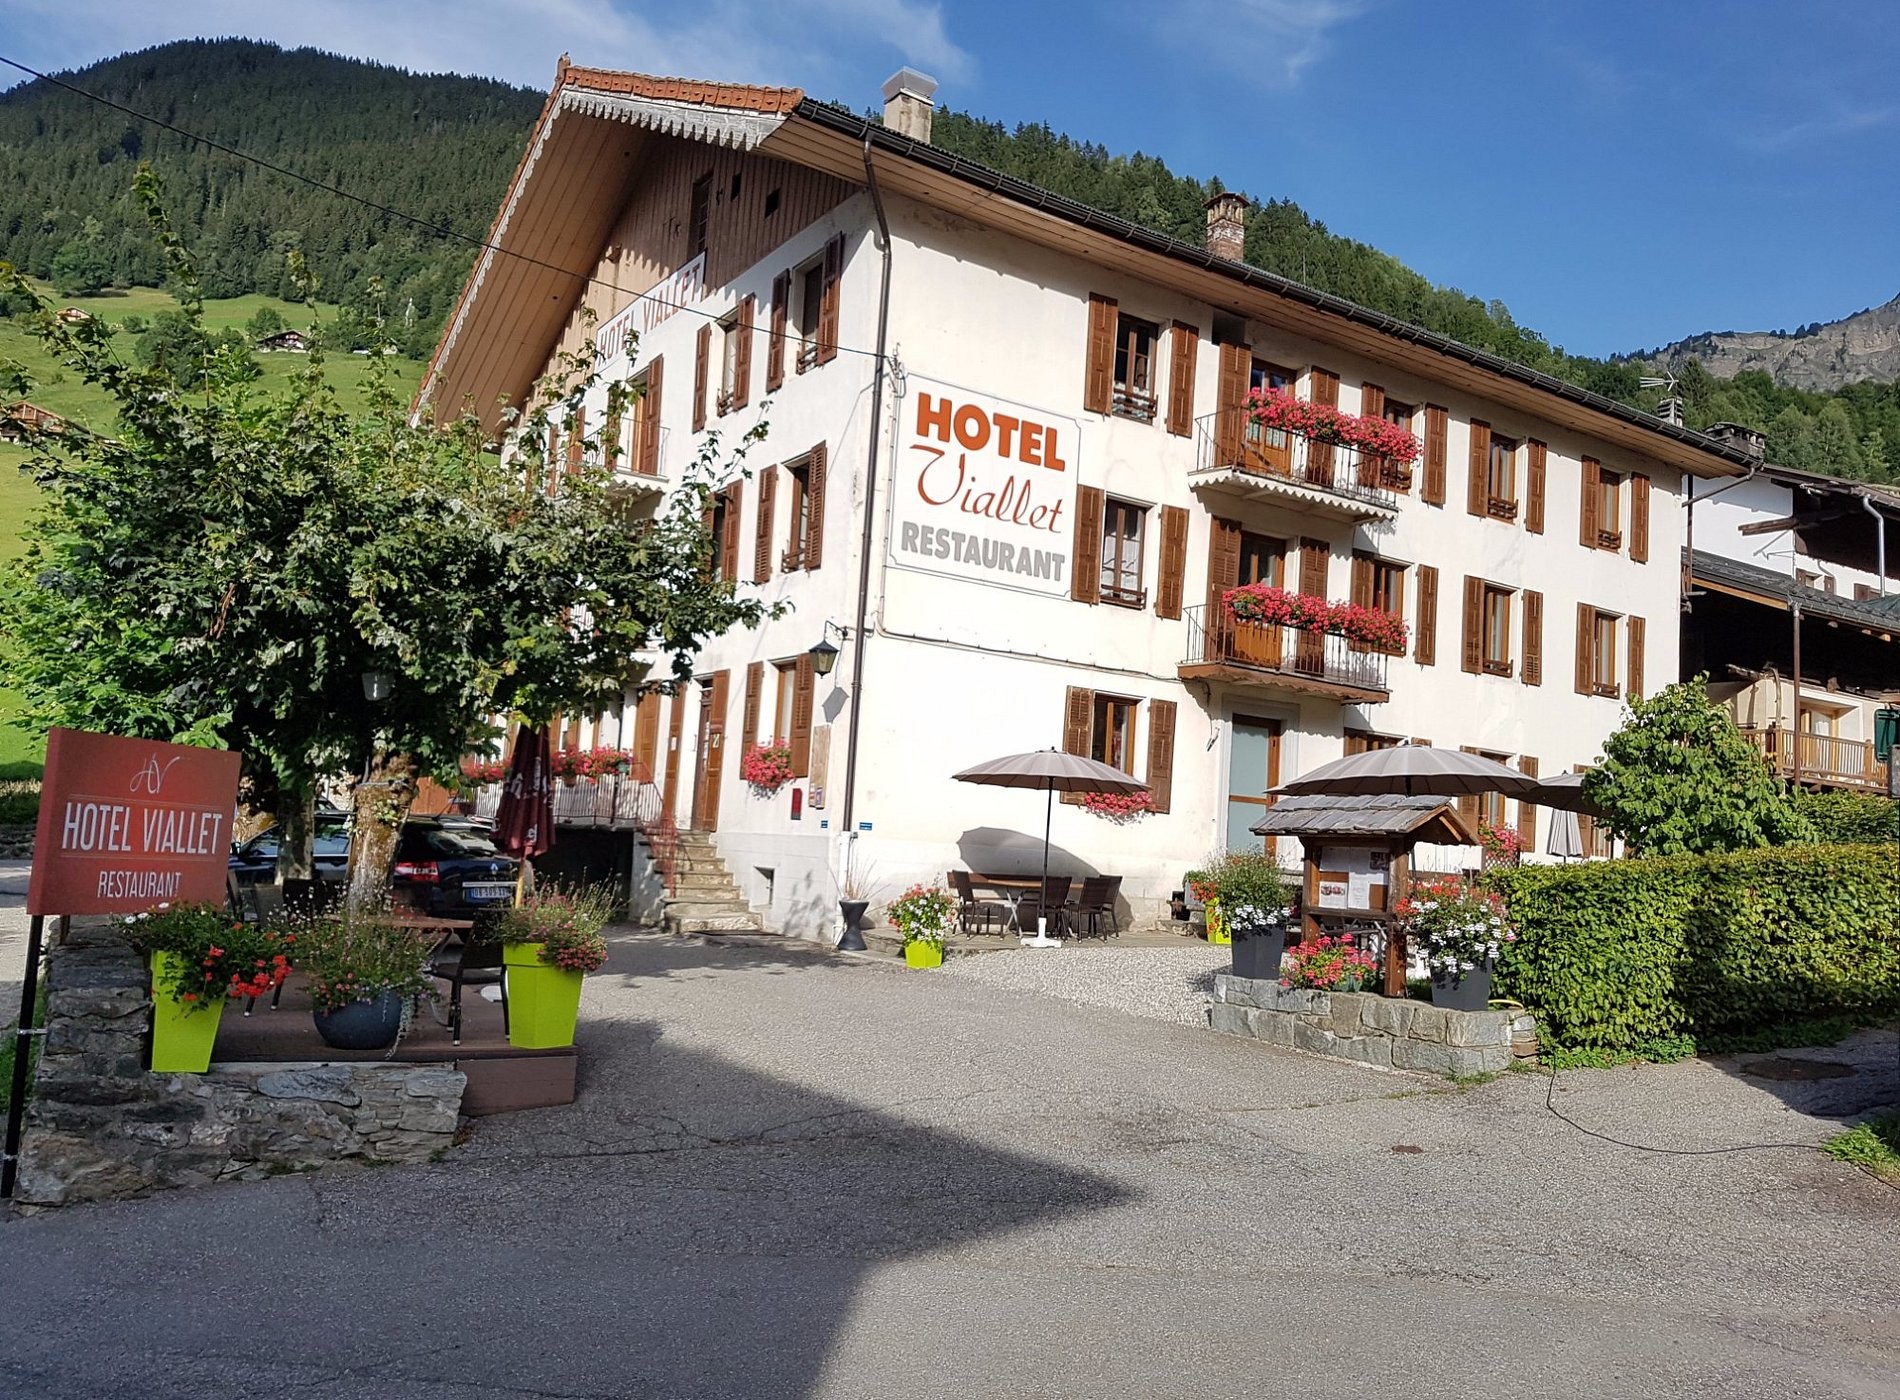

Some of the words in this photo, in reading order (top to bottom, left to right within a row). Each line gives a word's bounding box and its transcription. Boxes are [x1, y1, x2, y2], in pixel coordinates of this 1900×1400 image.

[643, 263, 700, 335] VIALLET
[916, 391, 1066, 472] HOTEL
[909, 444, 1063, 533] Viallet
[901, 521, 1065, 581] RESTAURANT
[61, 802, 132, 851] HOTEL
[142, 807, 223, 855] VIALLET
[97, 870, 182, 898] RESTAURANT
